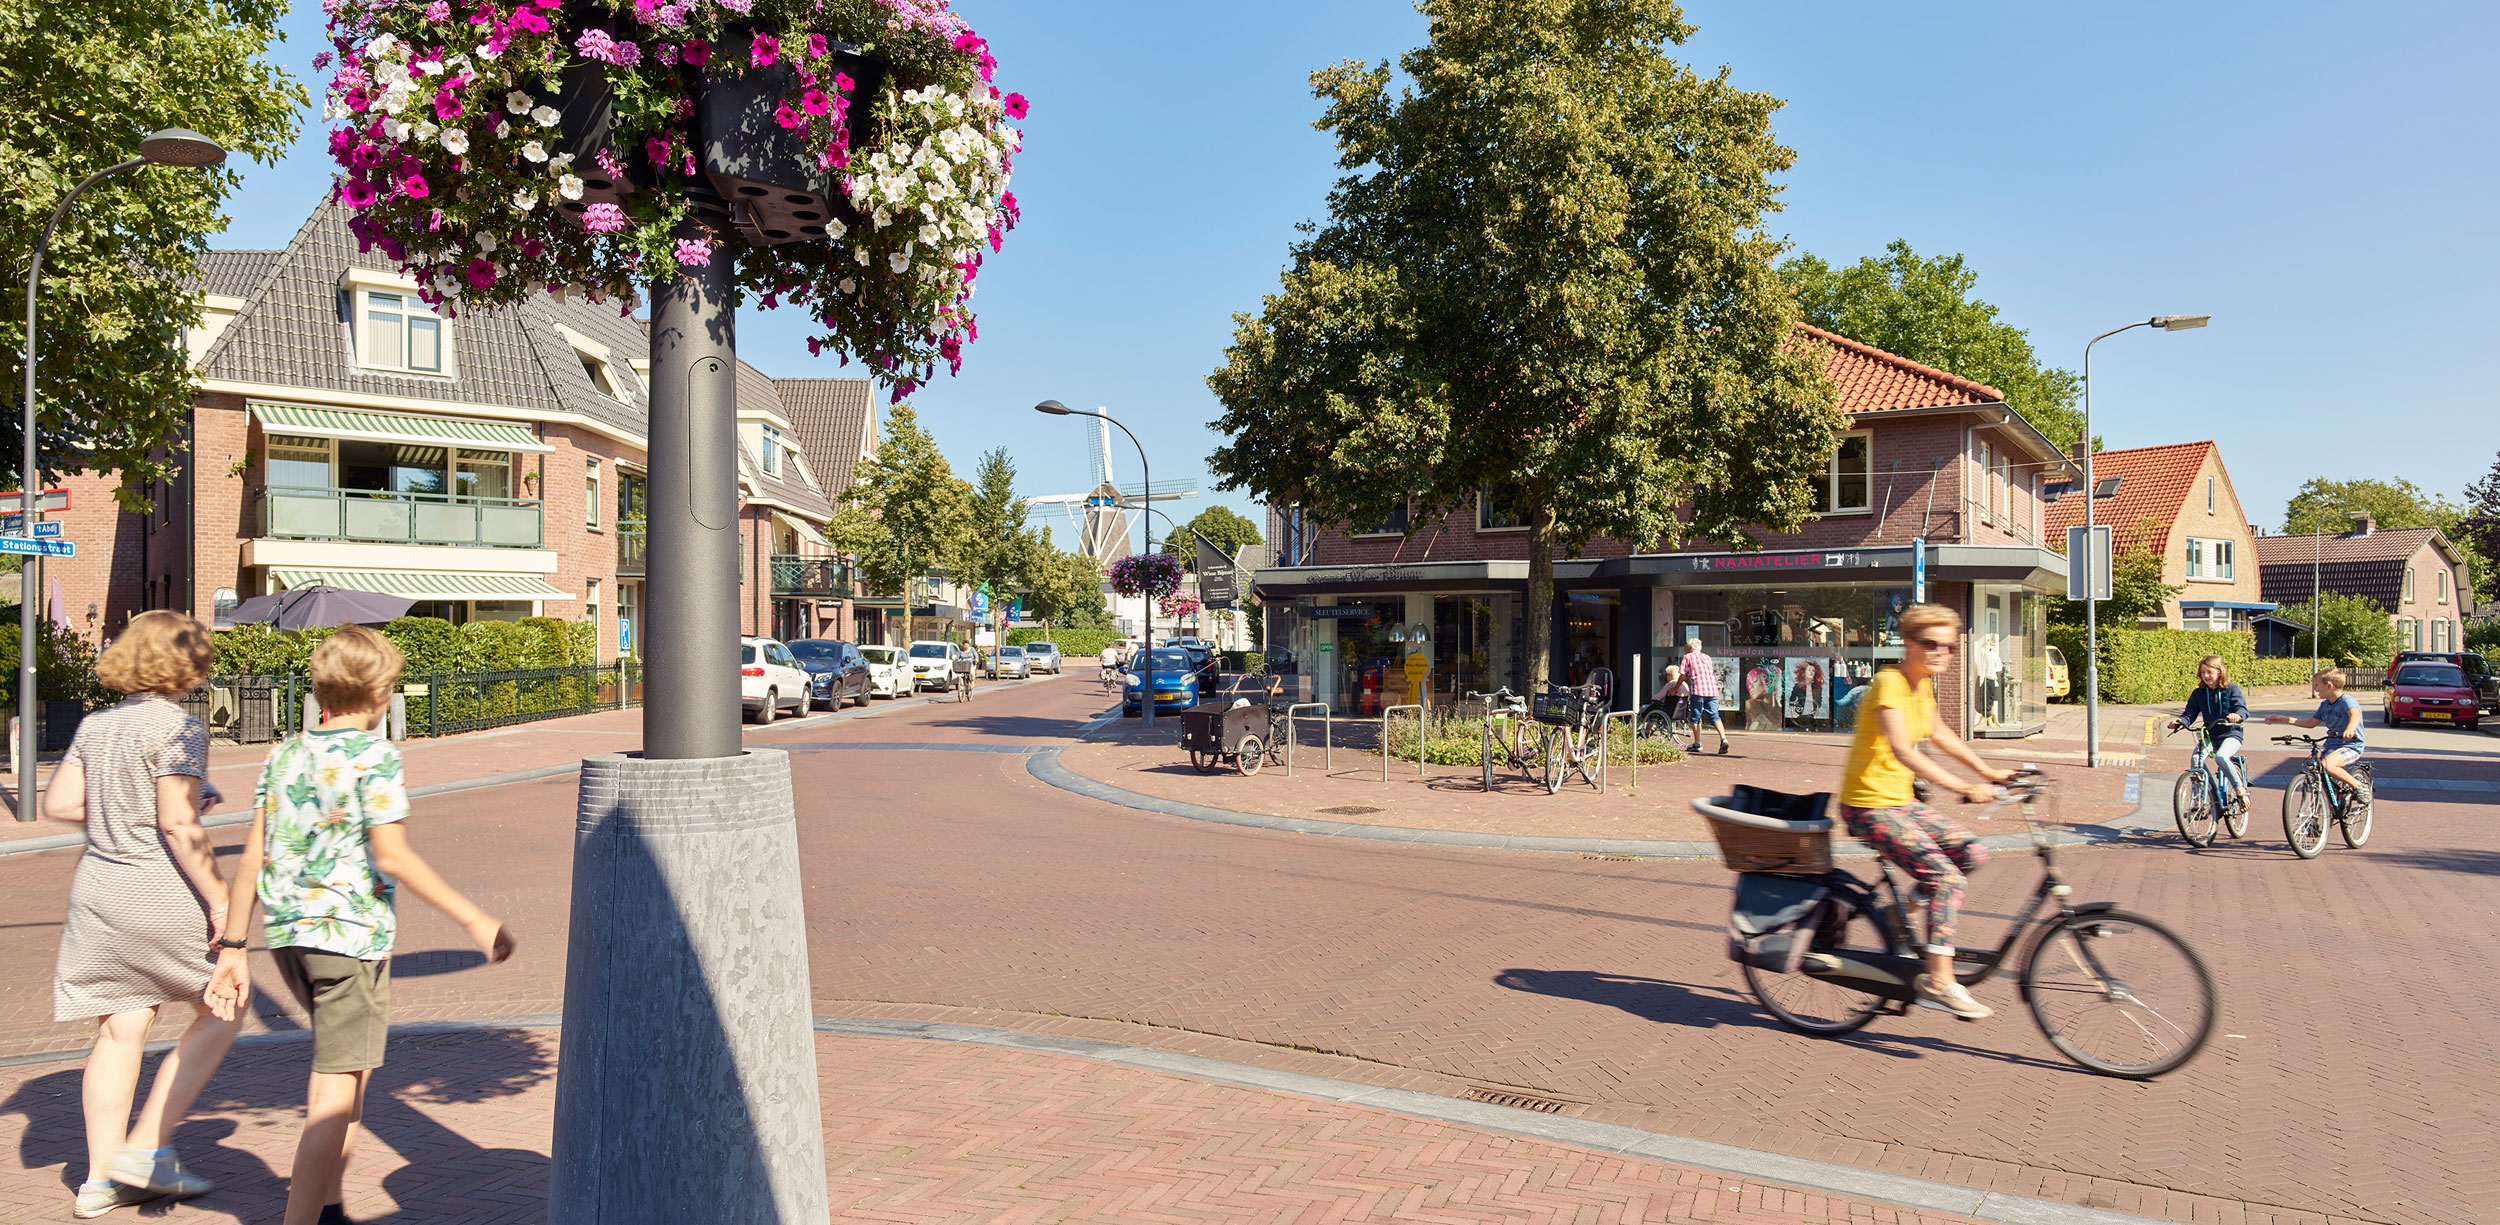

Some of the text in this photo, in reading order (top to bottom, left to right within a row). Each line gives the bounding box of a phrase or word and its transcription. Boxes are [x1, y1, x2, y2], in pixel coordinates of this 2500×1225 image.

[2, 540, 71, 553] Stationsstraat
[1714, 553, 1821, 568] NAAIATELIER
[1315, 608, 1370, 616] SLEUTELSERVICE
[1716, 647, 1764, 656] kapsalon
